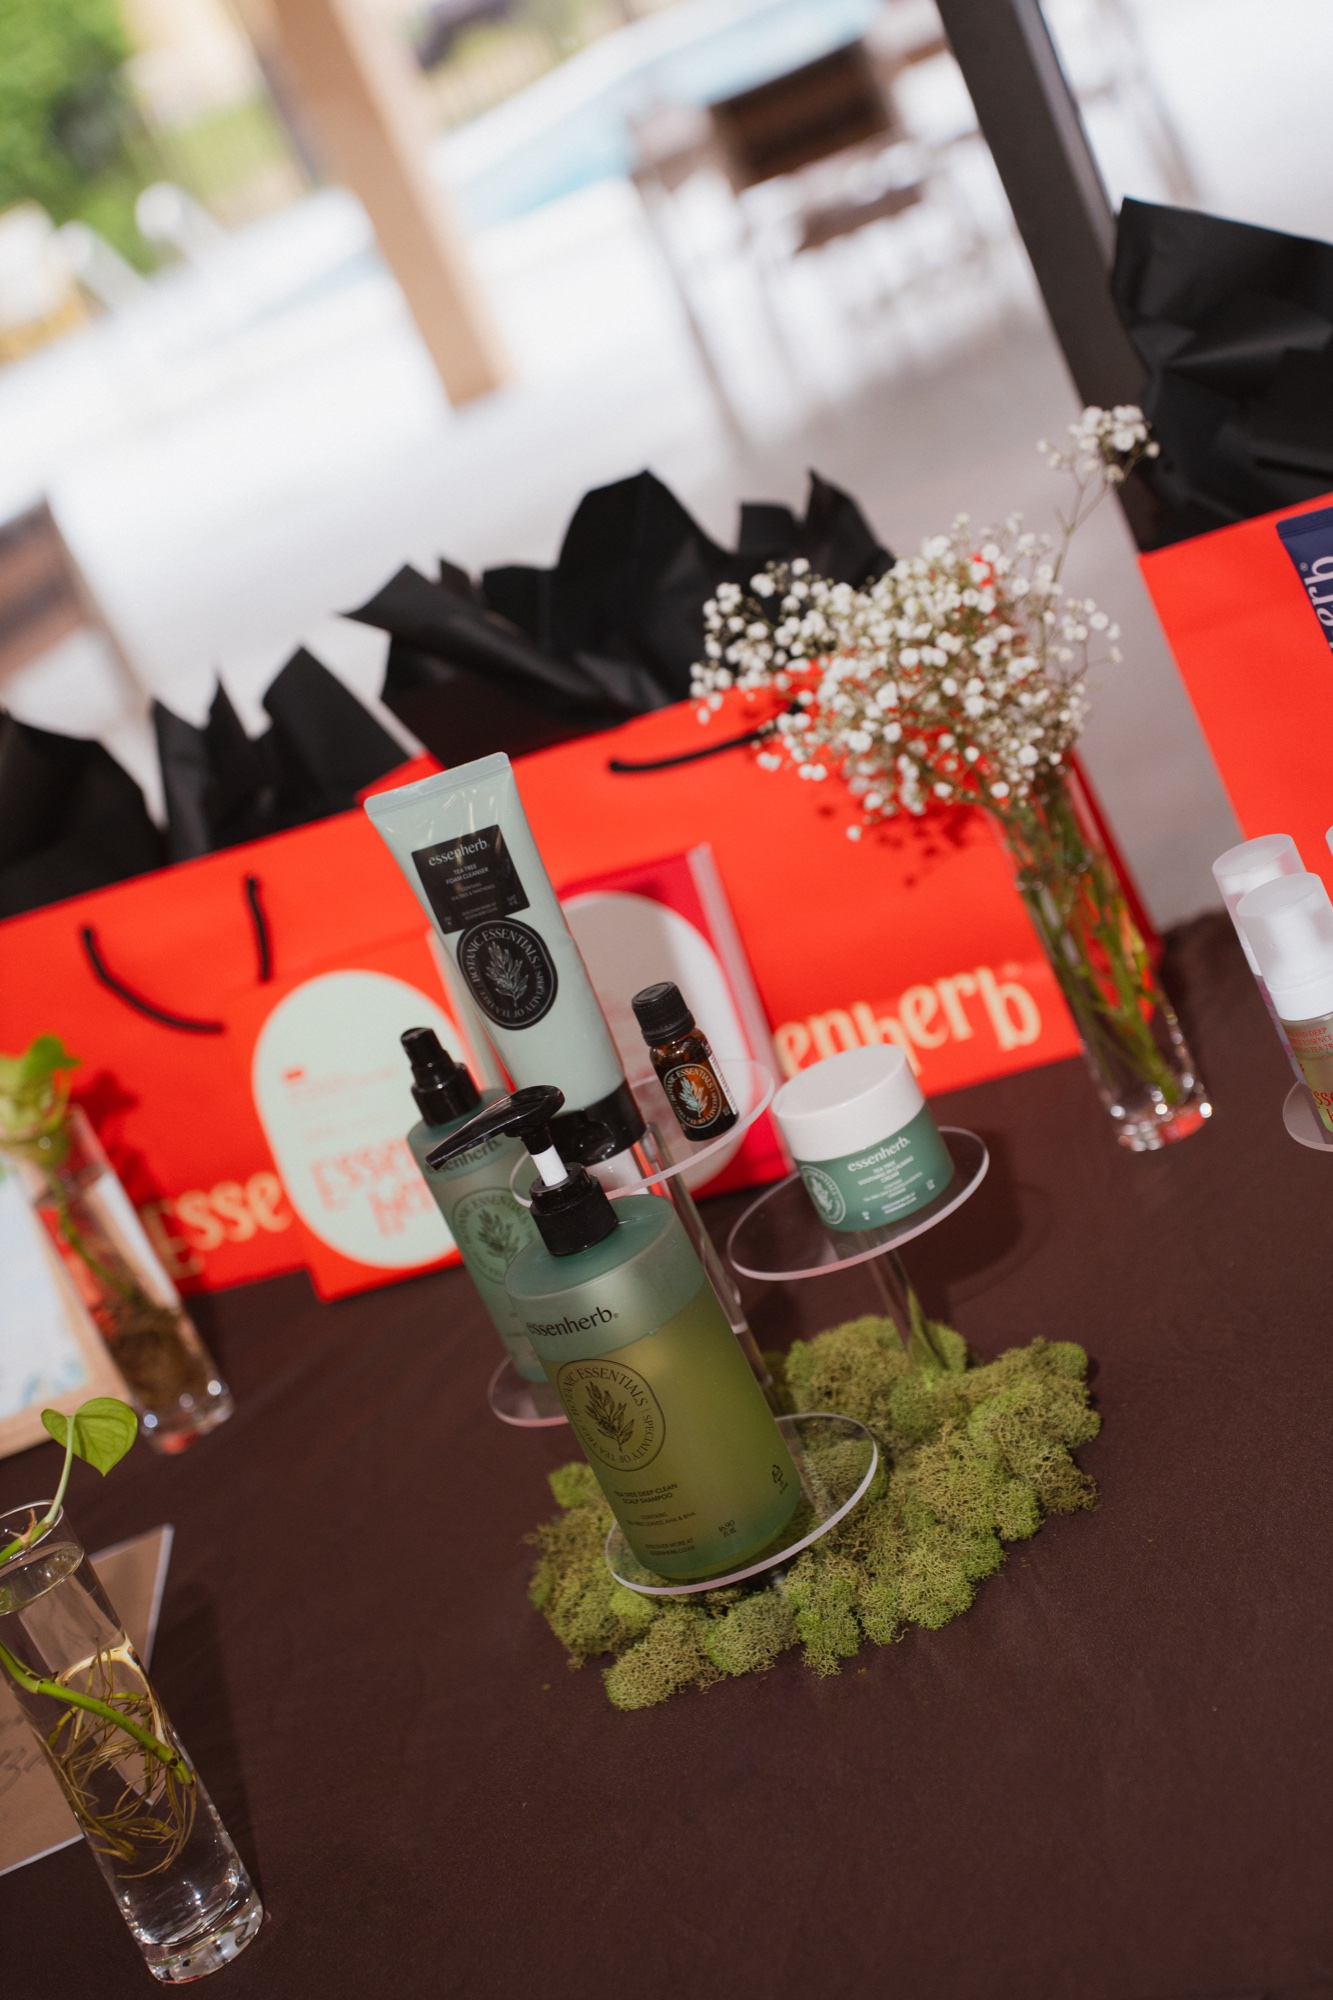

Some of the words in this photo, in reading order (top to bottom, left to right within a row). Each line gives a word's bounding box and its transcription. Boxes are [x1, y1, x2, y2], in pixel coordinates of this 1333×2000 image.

[428, 838, 487, 866] essenherb
[445, 874, 462, 885] FOAM
[463, 866, 489, 880] CLEANSER
[453, 867, 464, 875] TEA
[464, 863, 477, 873] TREE
[466, 936, 484, 983] BOTANIC
[481, 928, 541, 964] ESSENTIALS
[1308, 1027, 1327, 1037] DEEP
[847, 1136, 908, 1172] essenherb
[526, 1306, 613, 1336] essenherb
[576, 1367, 649, 1407] ESSENTIALS
[634, 1414, 655, 1461] SPECIALTY
[619, 1455, 631, 1464] OF
[638, 1489, 654, 1497] DEEP
[653, 1483, 678, 1494] CLEAN
[639, 1492, 673, 1504] SHAMPOO
